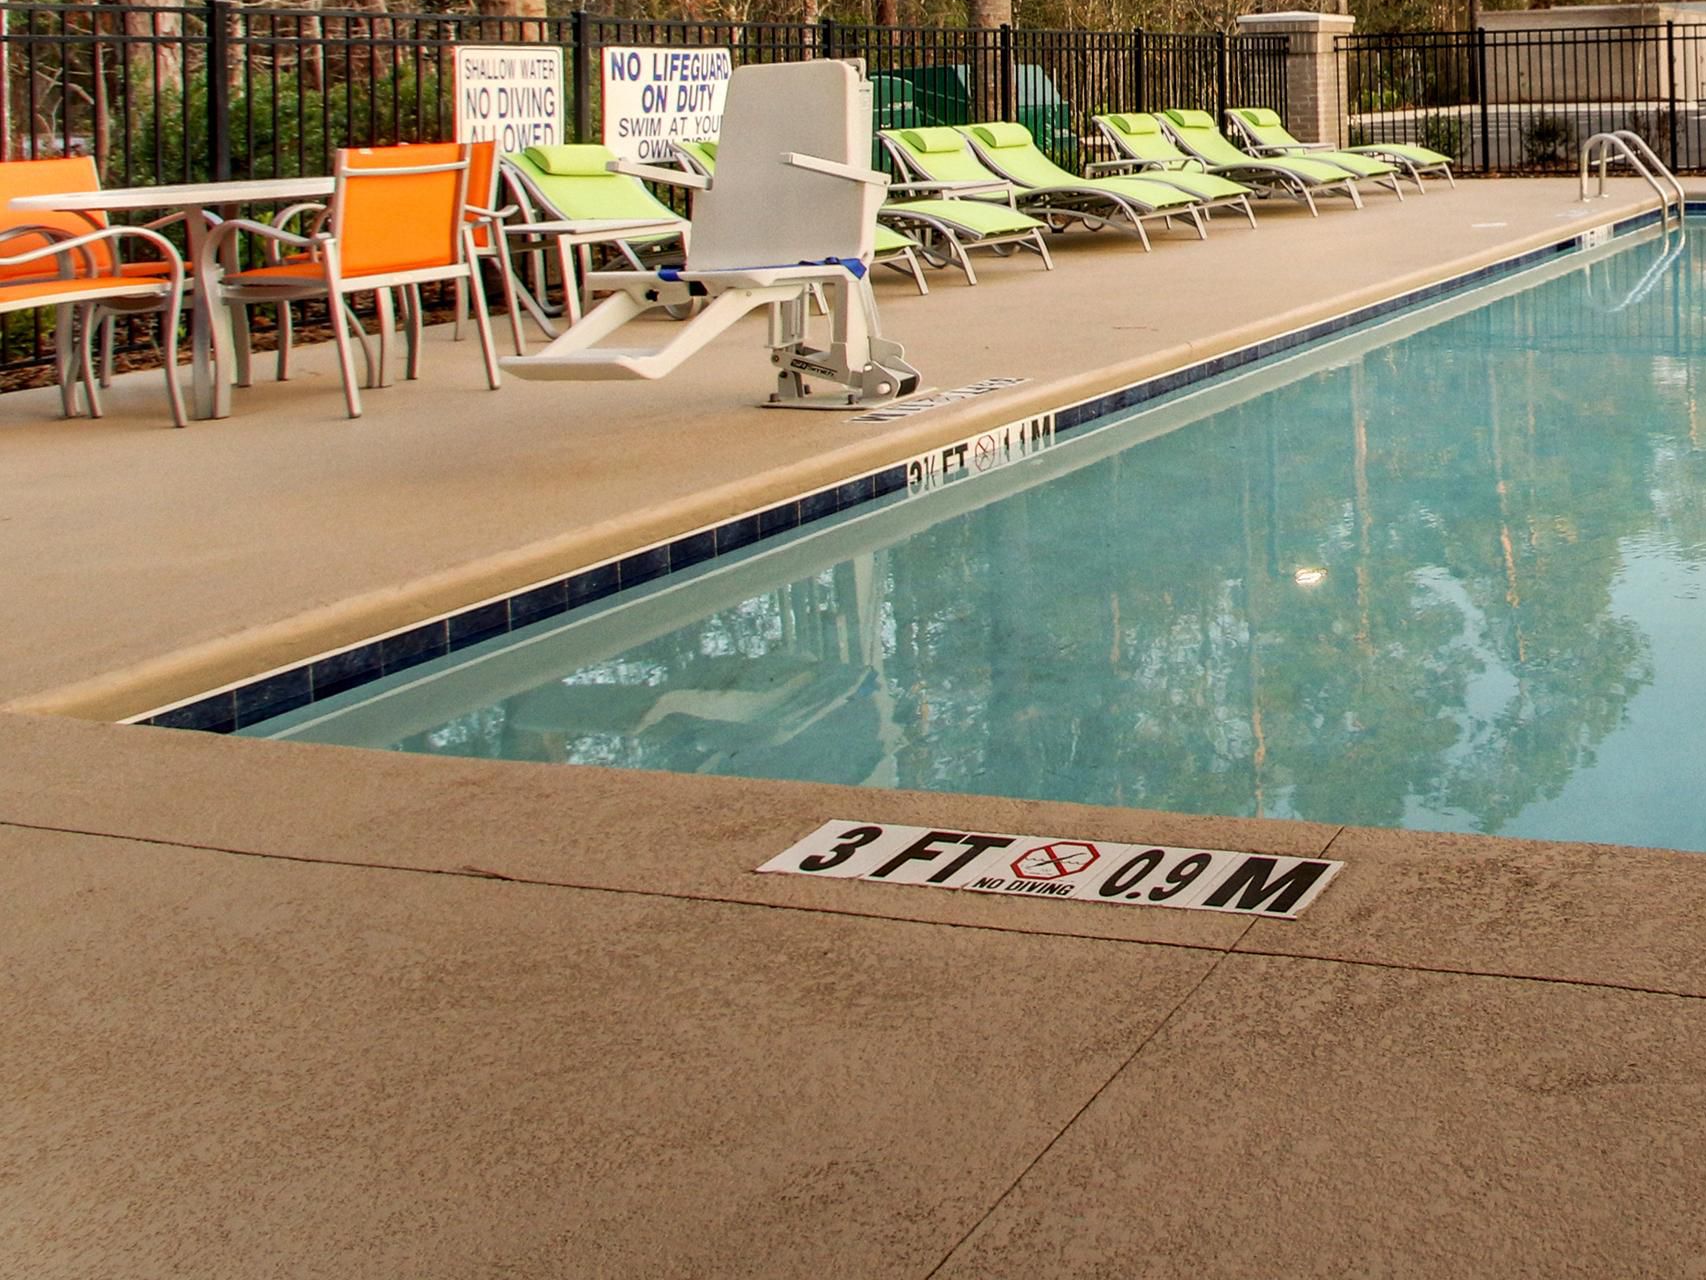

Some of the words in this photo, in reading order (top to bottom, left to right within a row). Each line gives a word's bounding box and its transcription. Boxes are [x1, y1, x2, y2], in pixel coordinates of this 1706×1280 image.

[465, 58, 516, 80] SHALLOW
[521, 58, 555, 80] WATER
[611, 52, 641, 81] NO
[653, 53, 729, 81] LIFEGUARD
[466, 87, 491, 119] NO
[497, 86, 556, 119] DIVING
[642, 84, 668, 113] ON
[676, 84, 716, 113] DUTY
[618, 117, 662, 138] SWIM
[668, 116, 689, 136] AT
[695, 115, 724, 135] YOU
[638, 139, 675, 159] OWN
[797, 825, 883, 873] 3
[870, 831, 1017, 885] FT
[1097, 848, 1213, 902] 0.9
[1200, 856, 1329, 914] M
[972, 877, 1006, 890] NO
[1004, 880, 1076, 897] DIVING
